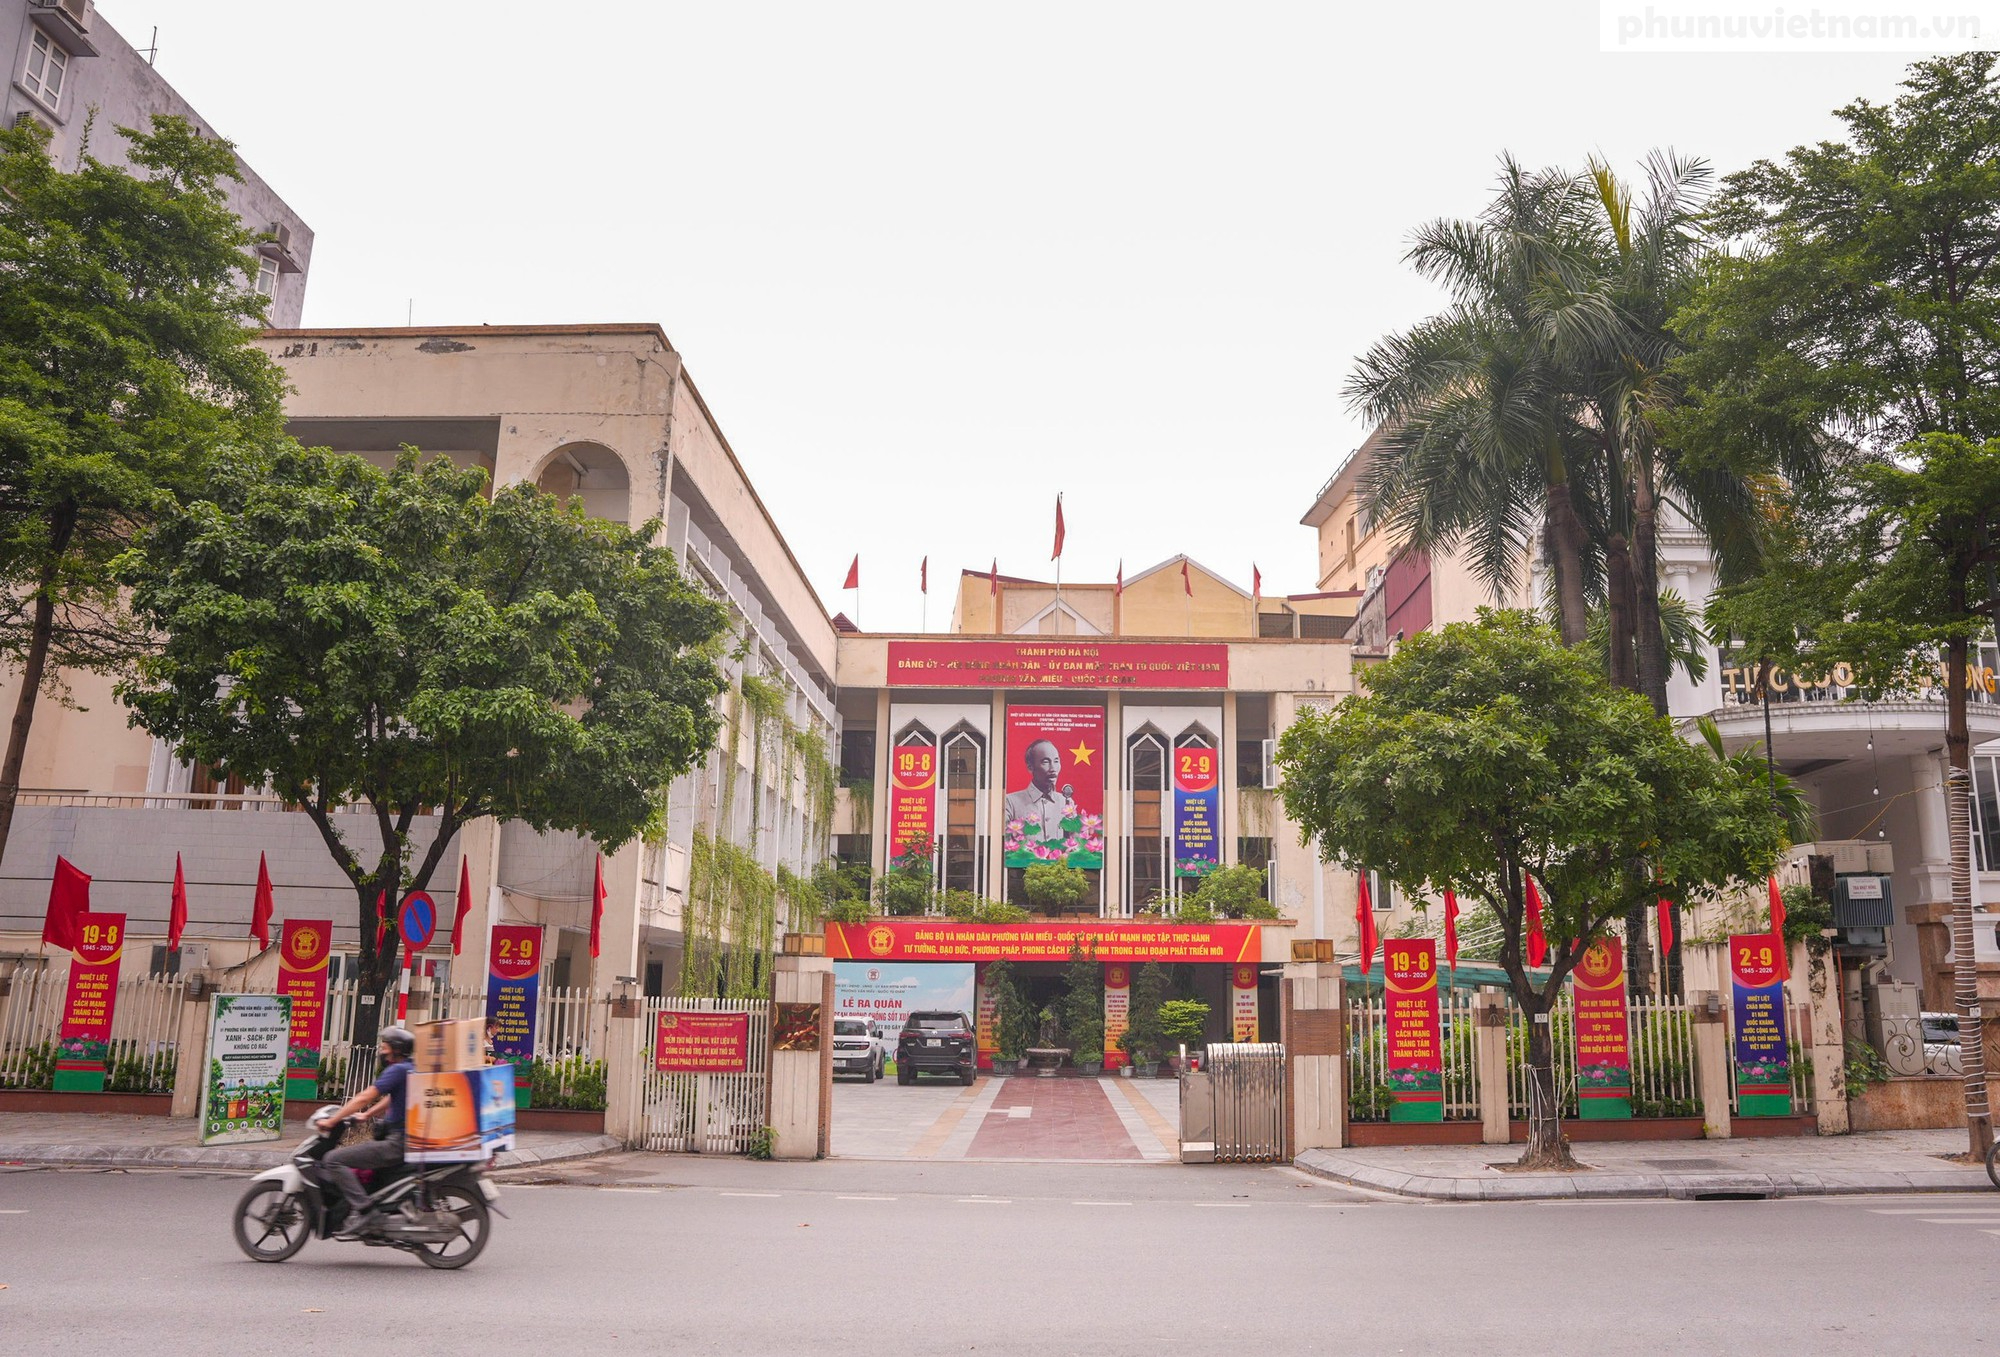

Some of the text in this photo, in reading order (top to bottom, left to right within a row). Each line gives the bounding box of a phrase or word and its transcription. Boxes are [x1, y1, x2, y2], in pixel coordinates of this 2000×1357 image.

[1016, 647, 1045, 656] THÀNH
[1048, 646, 1066, 656] PHỐ
[1068, 647, 1080, 656] HÀ
[899, 658, 923, 668] ĐẢNG
[899, 754, 930, 770] 19-8
[1181, 756, 1210, 772] 2-9
[83, 925, 118, 944] 19-8
[915, 930, 933, 940] ĐẢNG
[936, 931, 944, 942] BỘ
[946, 930, 954, 941] VÀ
[956, 931, 975, 941] NHÂN
[976, 931, 990, 942] DÂN
[992, 932, 1018, 942] PHƯỜNG
[1021, 931, 1034, 942] VĂN
[1036, 931, 1052, 942] MIẾU
[1058, 931, 1076, 942] QUỐC
[1105, 931, 1118, 942] ĐẨY
[1120, 933, 1140, 943] MẠNH
[1142, 933, 1156, 944] HỌC
[1173, 932, 1190, 944] THỰC
[1191, 932, 1210, 942] HÀNH
[499, 939, 533, 958] 2-9
[904, 944, 913, 953] TƯ
[940, 945, 953, 956] ĐẠO
[972, 945, 1000, 955] PHƯƠNG
[1022, 945, 1045, 955] PHONG
[1047, 944, 1065, 955] CÁCH
[1111, 946, 1133, 955] TRONG
[1134, 946, 1148, 955] GIAI
[1150, 946, 1168, 957] ĐOẠN
[1170, 945, 1187, 955] PHÁT
[1189, 944, 1208, 956] TRIỂN
[1210, 945, 1223, 956] MỚI
[1391, 952, 1429, 971] 19-8
[1739, 948, 1772, 966] 2-9
[96, 974, 108, 982] LIỆT
[89, 1000, 106, 1008] MẠNG
[874, 998, 902, 1008] QUÂN
[1396, 1000, 1426, 1008] NHIỆT LIỆT
[1412, 1010, 1429, 1018] MỪNG
[266, 1034, 277, 1043] ĐẸP
[1413, 1030, 1430, 1038] MẠNG
